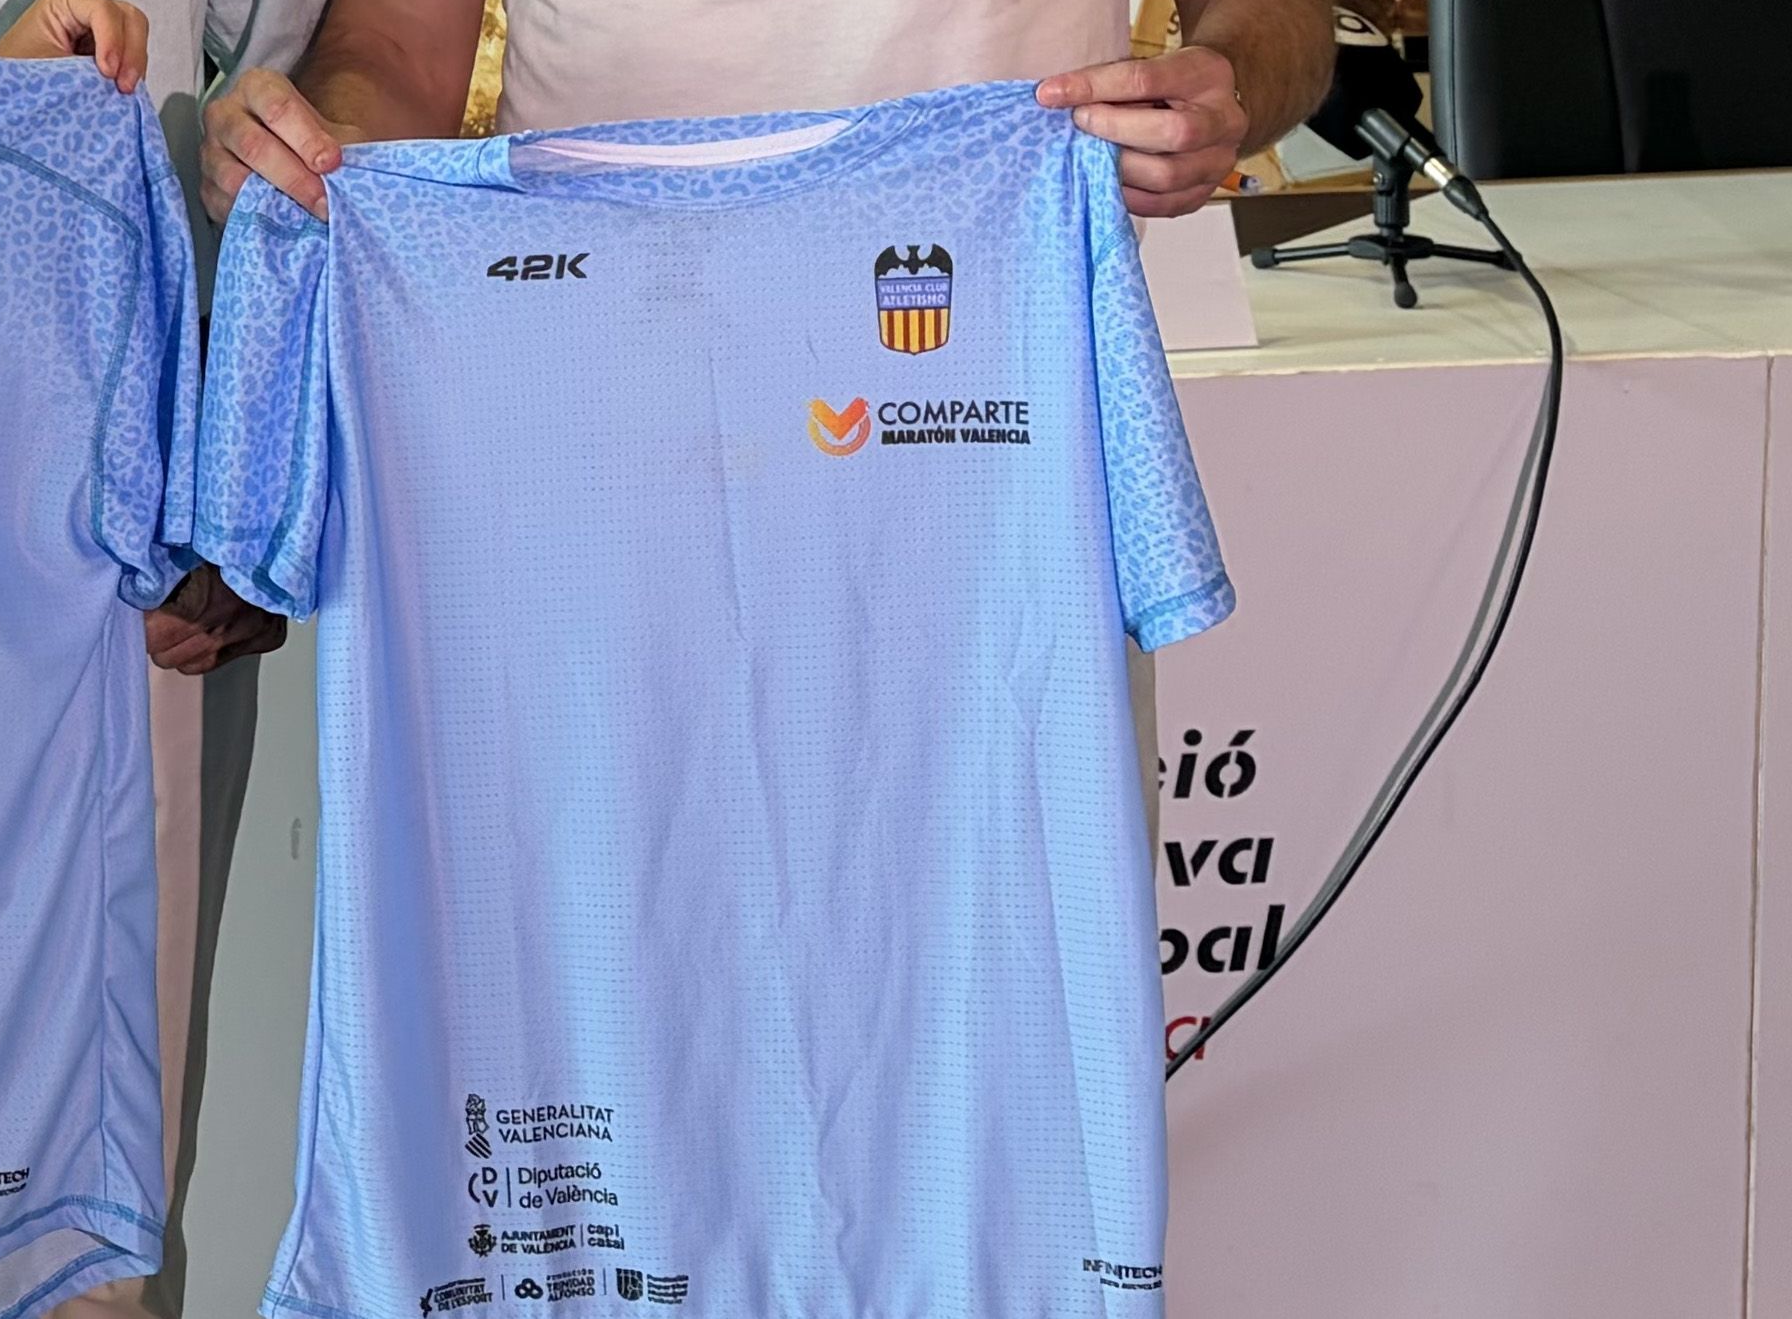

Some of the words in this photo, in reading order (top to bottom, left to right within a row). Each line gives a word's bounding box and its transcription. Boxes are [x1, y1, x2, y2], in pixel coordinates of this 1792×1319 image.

[487, 252, 591, 282] 42K
[880, 282, 923, 294] VALENCIA
[924, 281, 948, 292] CLUB
[882, 293, 946, 306] ATLETISMO
[878, 400, 1030, 426] COMPARTE
[881, 425, 956, 445] MARATÓN
[960, 429, 1031, 445] VALENCIA
[1159, 729, 1257, 799] ió
[496, 1104, 614, 1125] GENERALITAT
[499, 1123, 613, 1143] VALENCIANA
[518, 1162, 602, 1188] Diputació
[519, 1192, 543, 1208] de
[545, 1185, 618, 1206] València
[501, 1224, 576, 1241] AJUNTAMENT
[501, 1243, 517, 1253] DE
